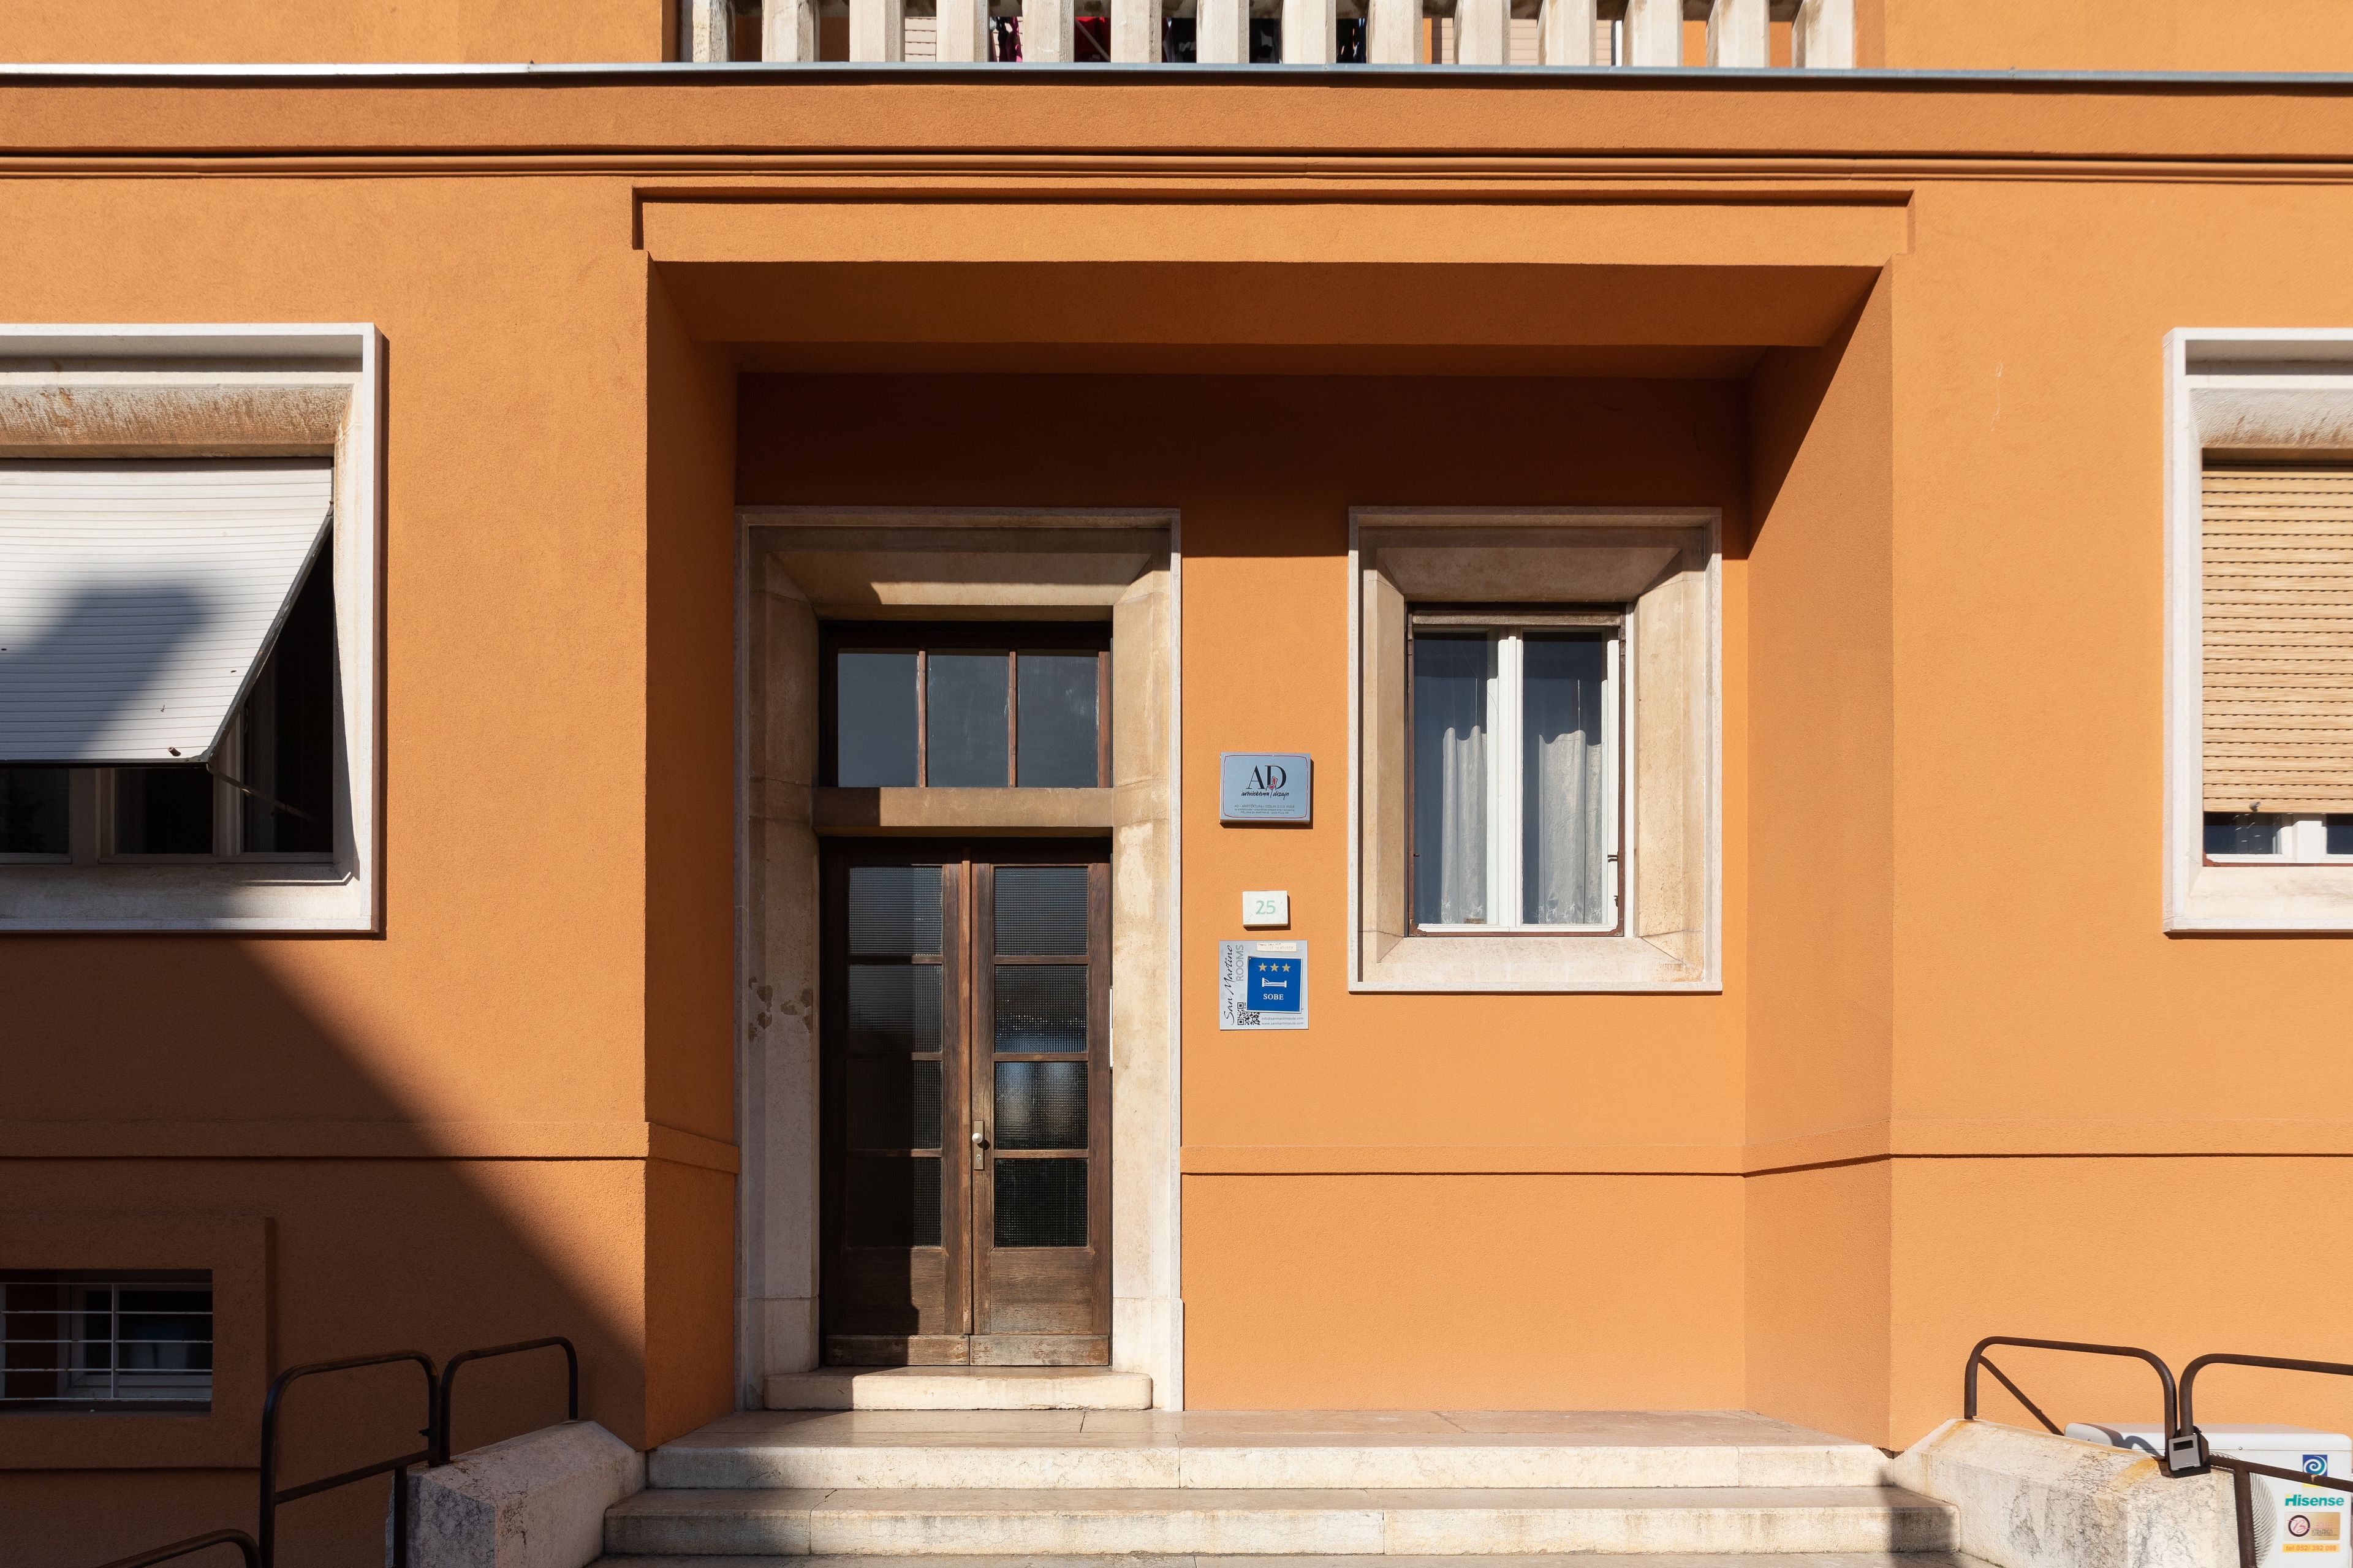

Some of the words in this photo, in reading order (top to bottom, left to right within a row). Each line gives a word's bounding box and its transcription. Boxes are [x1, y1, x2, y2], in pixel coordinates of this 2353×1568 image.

[1246, 765, 1287, 789] AD
[1273, 790, 1289, 801] dizajn
[1256, 900, 1276, 915] 25
[1223, 945, 1237, 996] Martino
[1224, 996, 1235, 1026] San
[2284, 1494, 2344, 1507] Hisense
